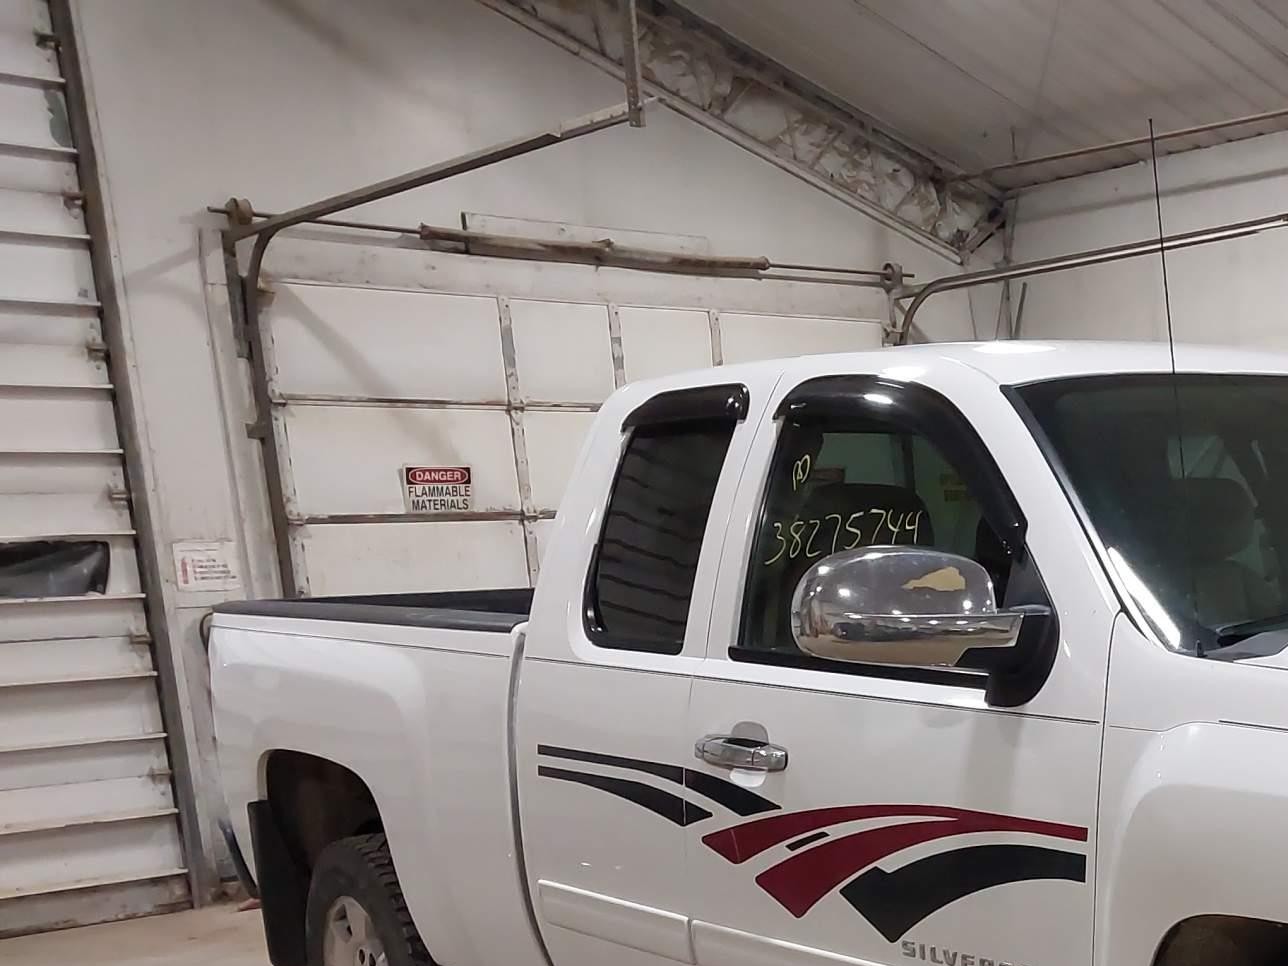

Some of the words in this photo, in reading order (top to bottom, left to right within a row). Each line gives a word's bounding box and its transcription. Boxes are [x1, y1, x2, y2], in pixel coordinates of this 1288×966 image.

[415, 471, 461, 481] DANGER
[408, 486, 471, 498] FLAMMABLE
[412, 499, 469, 511] MATERIALS
[764, 508, 923, 565] 38275744
